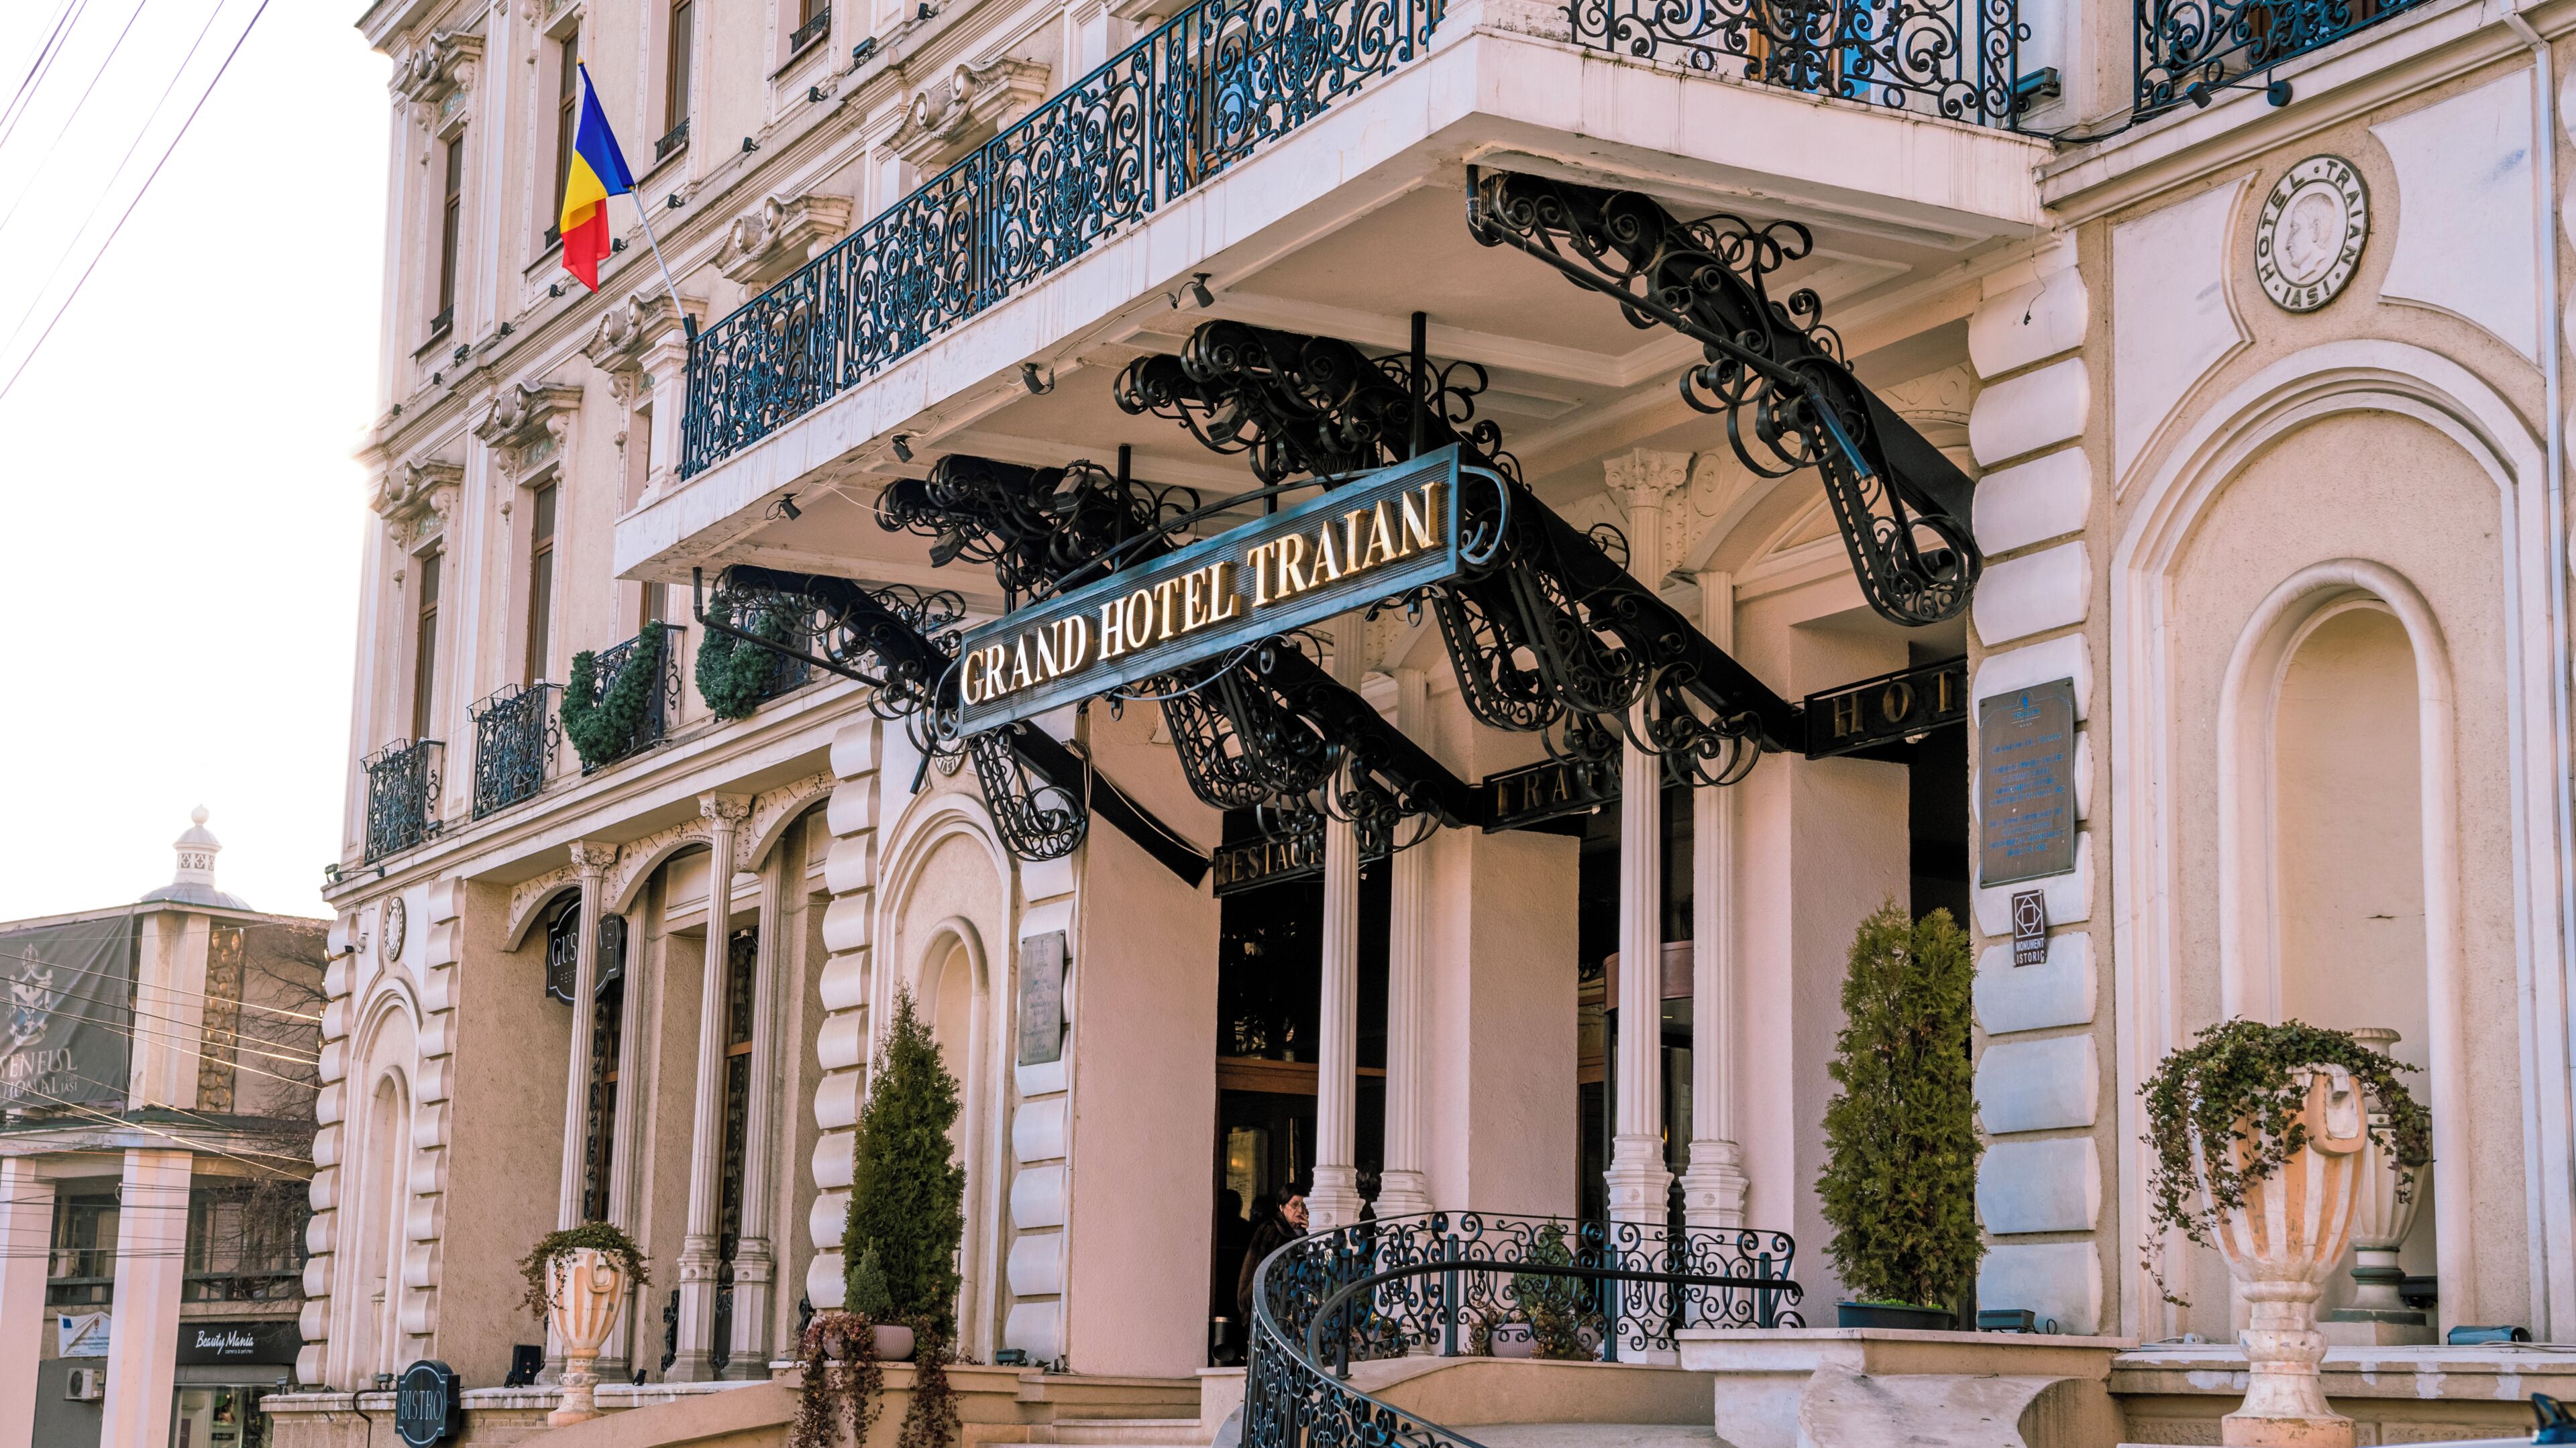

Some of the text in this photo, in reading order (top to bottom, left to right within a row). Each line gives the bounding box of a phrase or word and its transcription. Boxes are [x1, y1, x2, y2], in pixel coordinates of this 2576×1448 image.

[2258, 160, 2363, 283] HOTEL TRAIAN
[2282, 279, 2330, 308] IASI
[961, 482, 1443, 705] GRAND HOTEL TRAIAN
[1833, 668, 1960, 738] HOT
[941, 759, 957, 773] IASI
[1495, 757, 1623, 816] TRAIA
[1215, 836, 1315, 886] RESTAU
[2016, 938, 2045, 952] MONUMENT
[2017, 950, 2045, 964] ISTORIC
[196, 1330, 254, 1355] Beauty Mania
[401, 1390, 443, 1420] BISTRO
